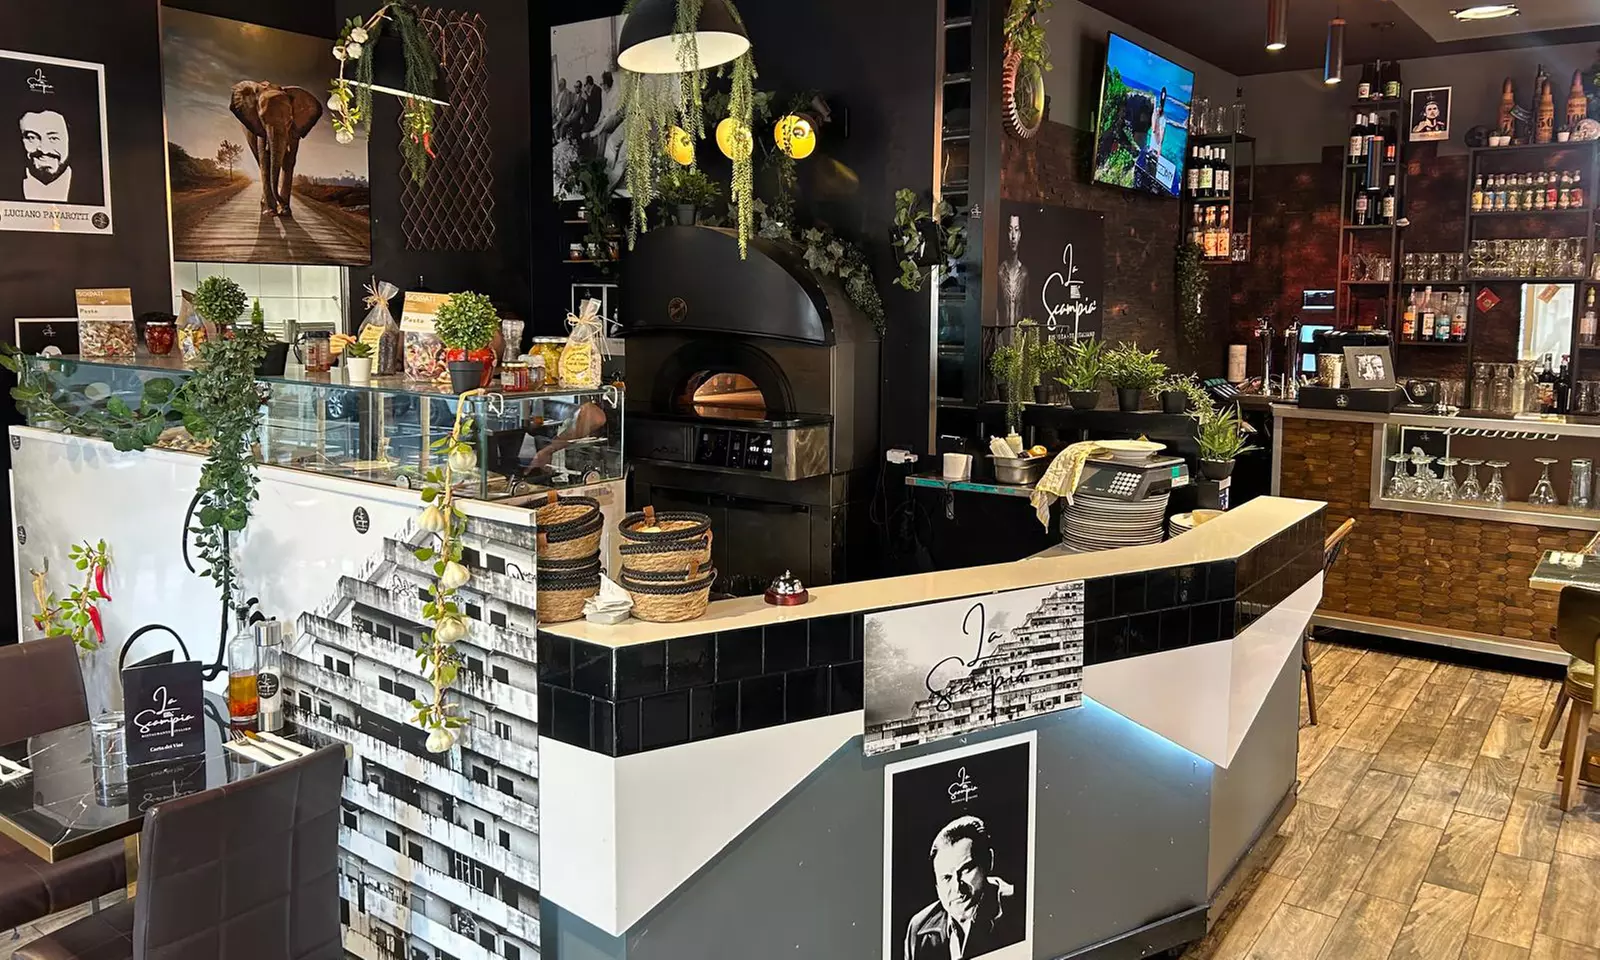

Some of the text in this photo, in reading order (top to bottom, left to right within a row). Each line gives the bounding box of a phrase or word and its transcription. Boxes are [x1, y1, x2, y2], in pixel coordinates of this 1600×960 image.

[4, 209, 90, 221] LUCIANO PAVAROTTI
[1063, 243, 1084, 287] La
[404, 316, 424, 324] Pasta
[153, 686, 181, 716] La
[133, 708, 195, 737] Scampia
